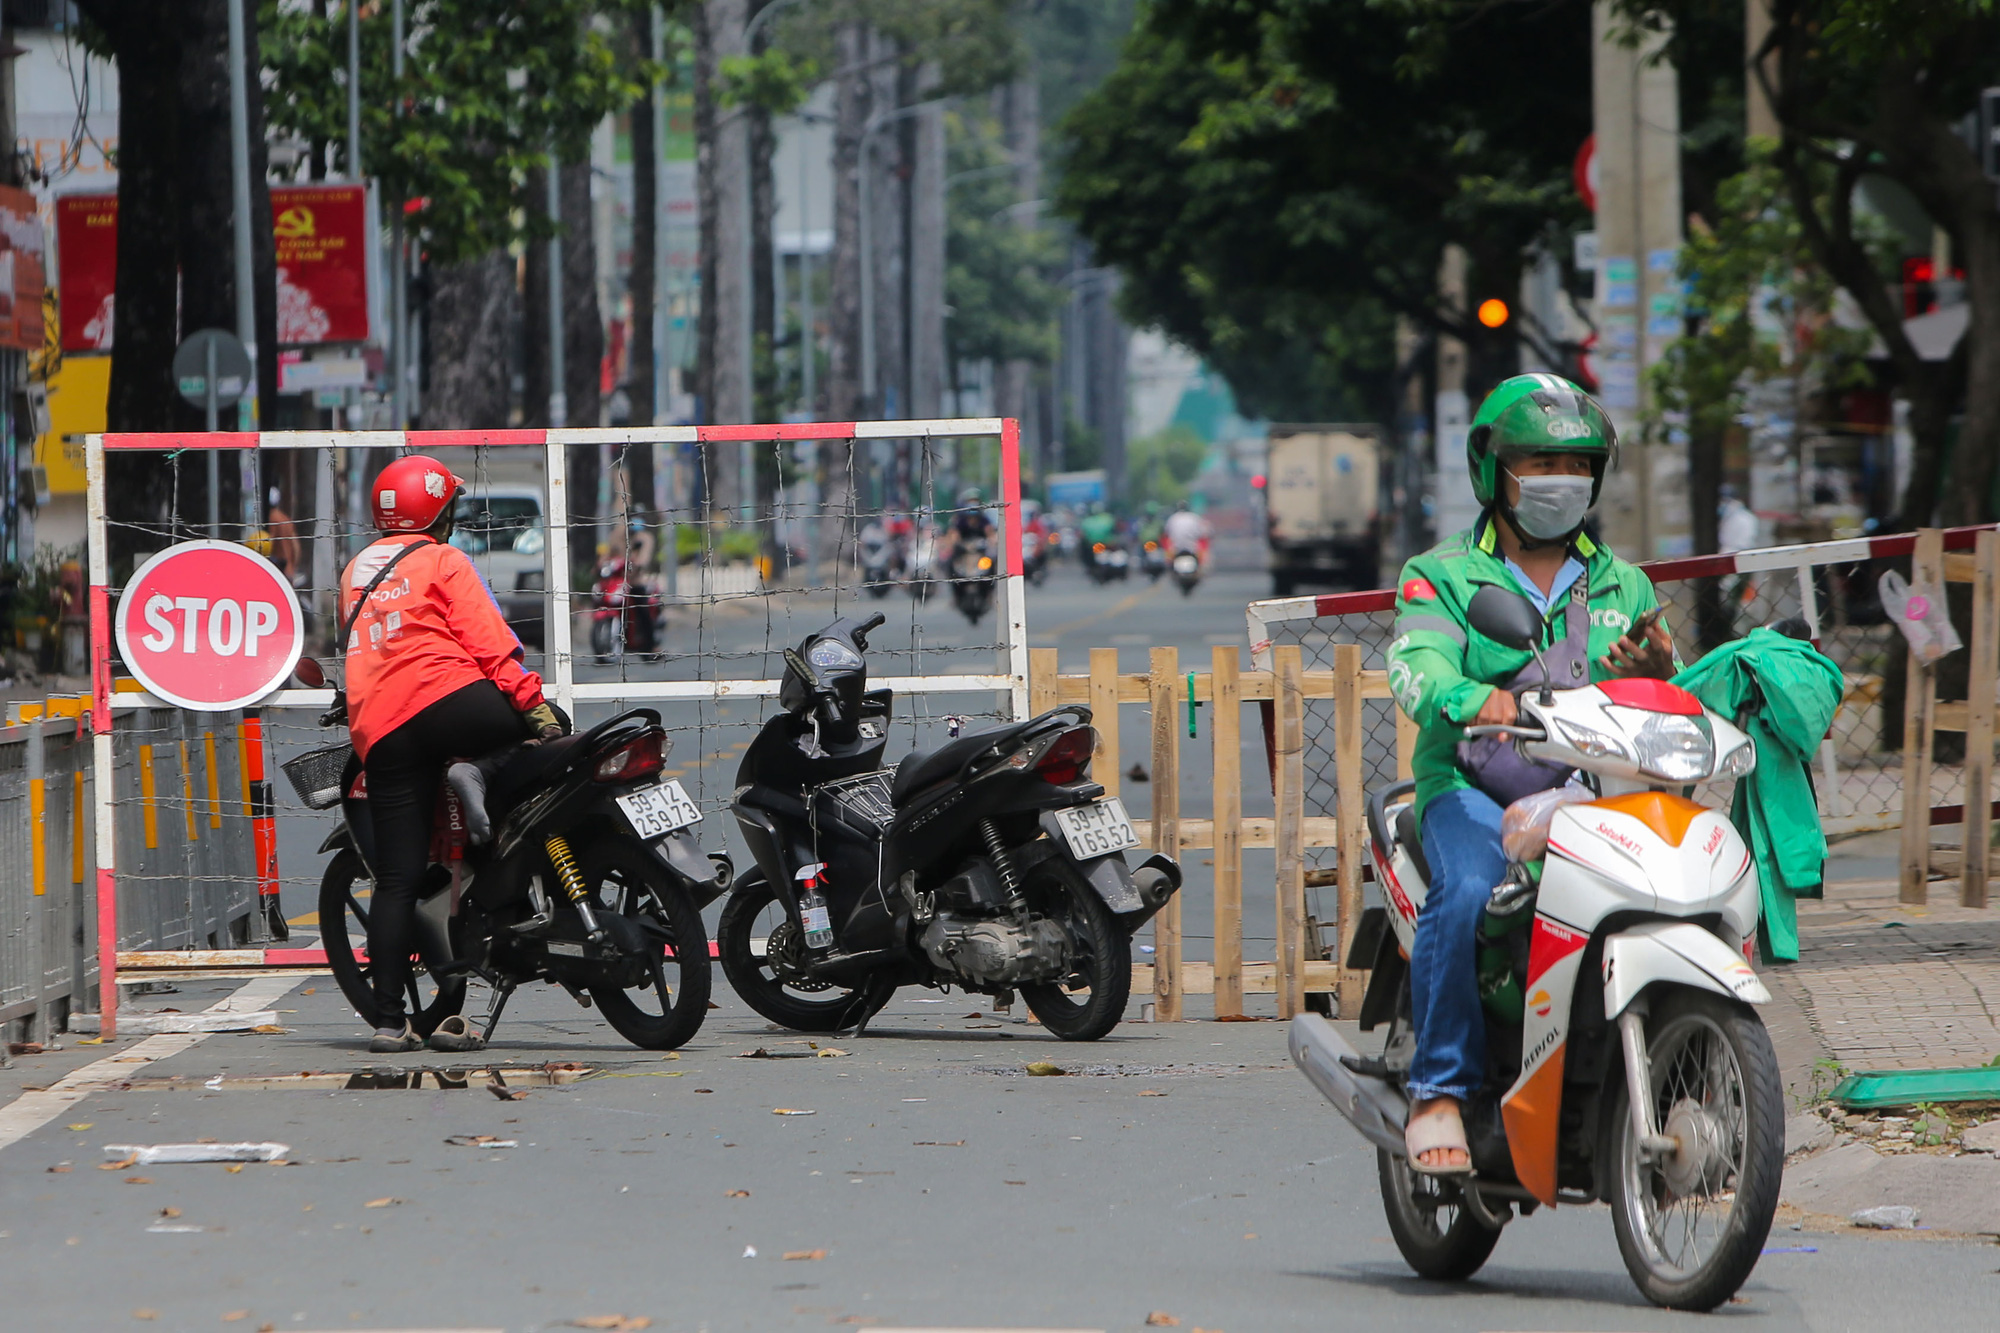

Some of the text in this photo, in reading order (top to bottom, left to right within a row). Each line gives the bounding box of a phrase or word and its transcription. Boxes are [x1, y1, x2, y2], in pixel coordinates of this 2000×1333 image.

[1547, 418, 1591, 438] Grab
[141, 594, 279, 657] STOP
[627, 785, 680, 814] 59-T2
[636, 802, 698, 836] 259.73
[1067, 803, 1117, 832] 59-F1
[1072, 823, 1135, 856] 165.52
[1523, 1026, 1560, 1070] REPSOL
